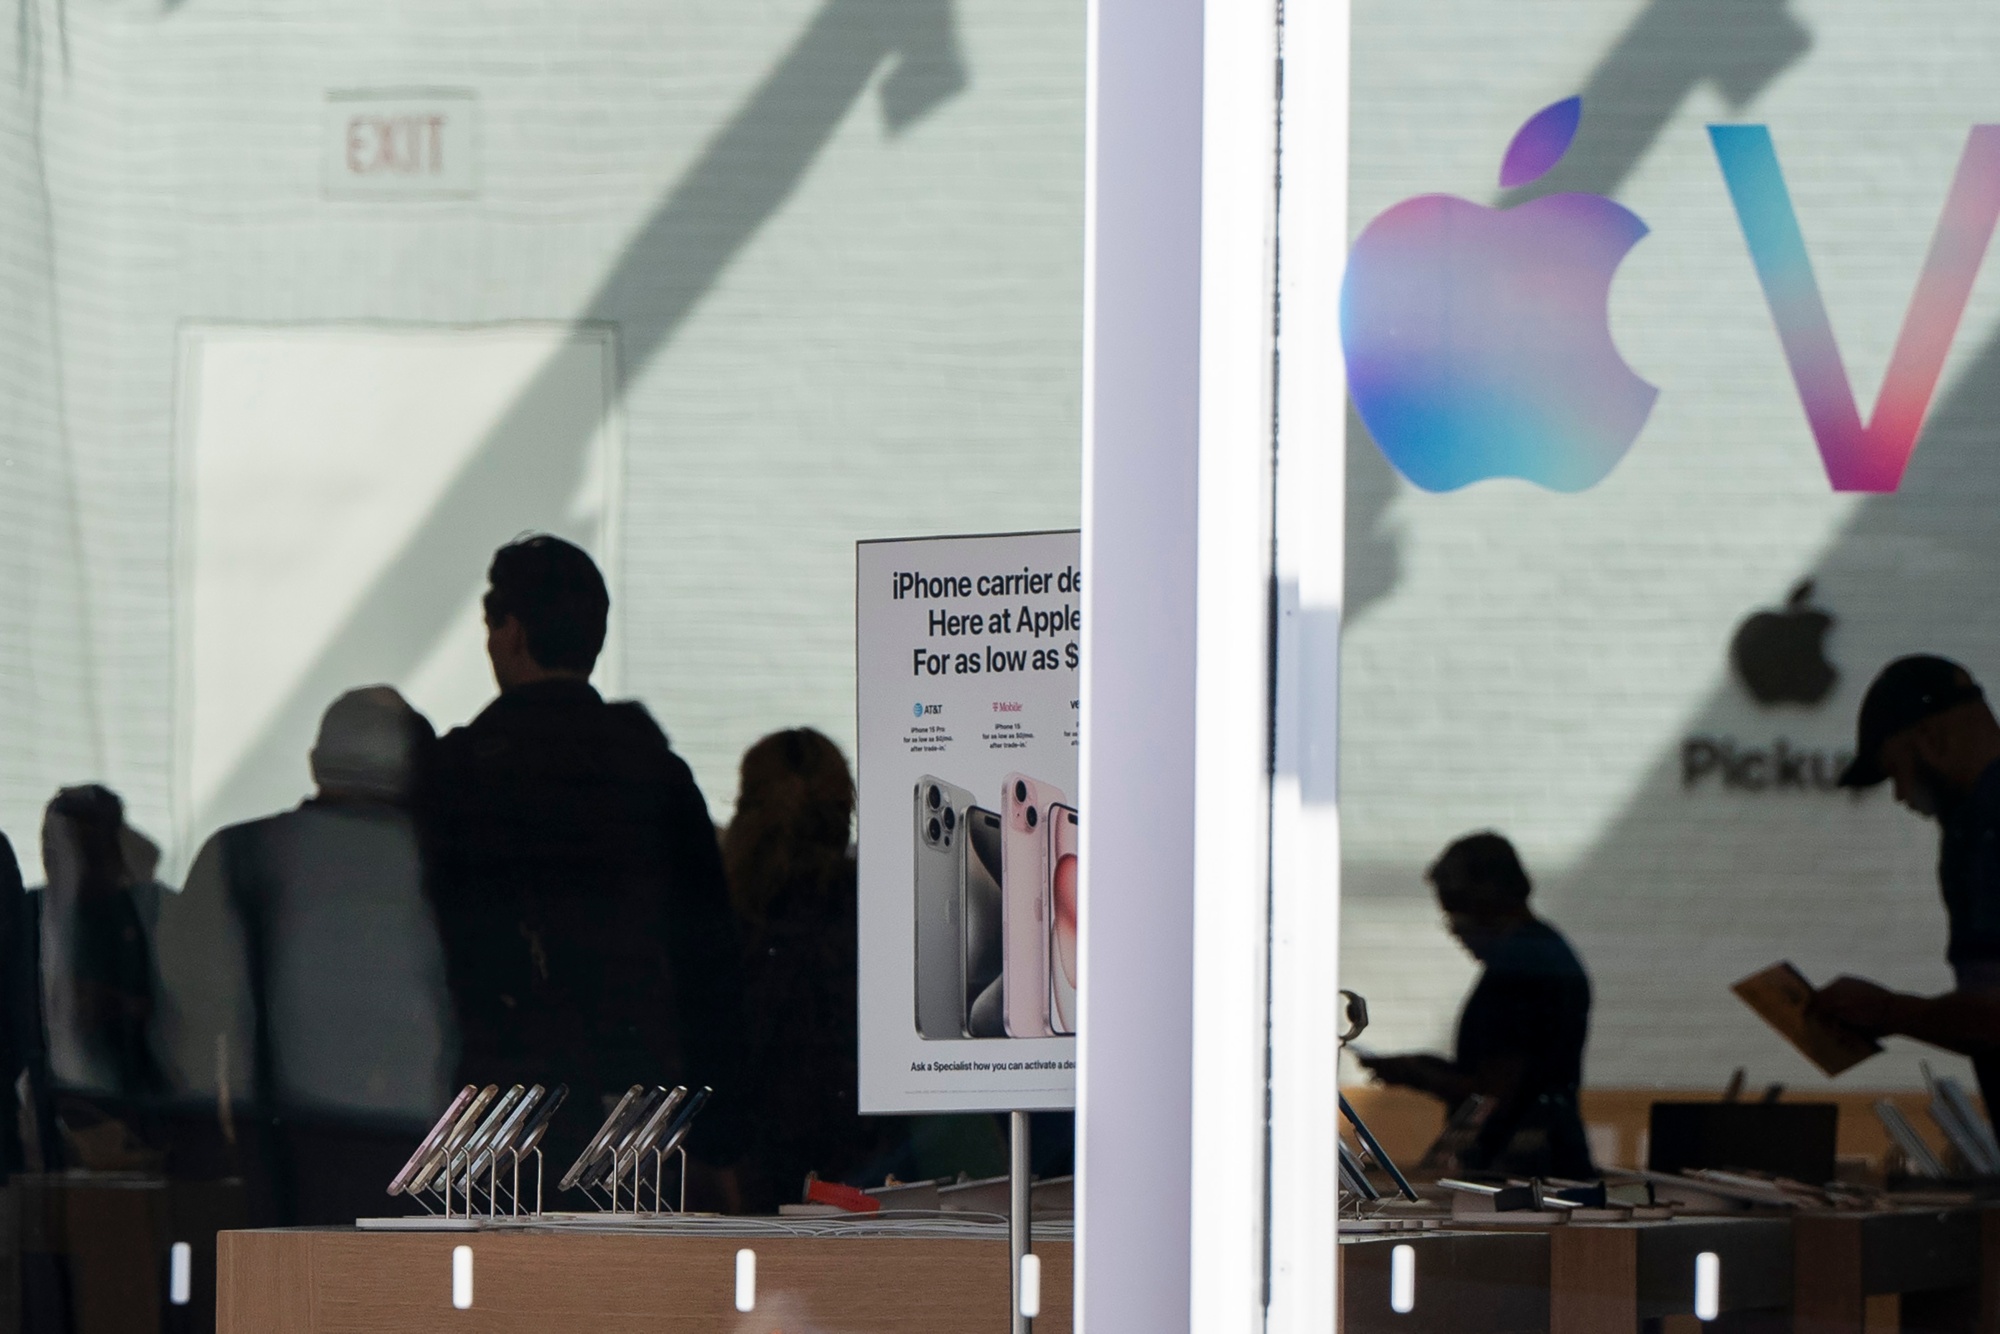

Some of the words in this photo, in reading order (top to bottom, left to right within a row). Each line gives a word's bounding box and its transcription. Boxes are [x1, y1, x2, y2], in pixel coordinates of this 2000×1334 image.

[346, 113, 449, 175] EXIT
[892, 570, 972, 600] iPhone
[976, 566, 1053, 596] carrier
[928, 609, 984, 637] Here
[988, 607, 1011, 635] at
[1016, 604, 1081, 639] Apple
[913, 648, 950, 676] For
[954, 652, 981, 675] as
[986, 645, 1027, 673] low
[1031, 647, 1059, 671] as
[924, 704, 943, 714] AT&T
[1681, 736, 1858, 802] Picku
[910, 1061, 926, 1072] Ask
[927, 1063, 932, 1071] a
[933, 1060, 972, 1073] Specialist
[973, 1061, 990, 1071] how
[992, 1062, 1007, 1073] you
[1008, 1062, 1023, 1071] can
[1024, 1060, 1056, 1070] activate
[1058, 1061, 1062, 1069] a
